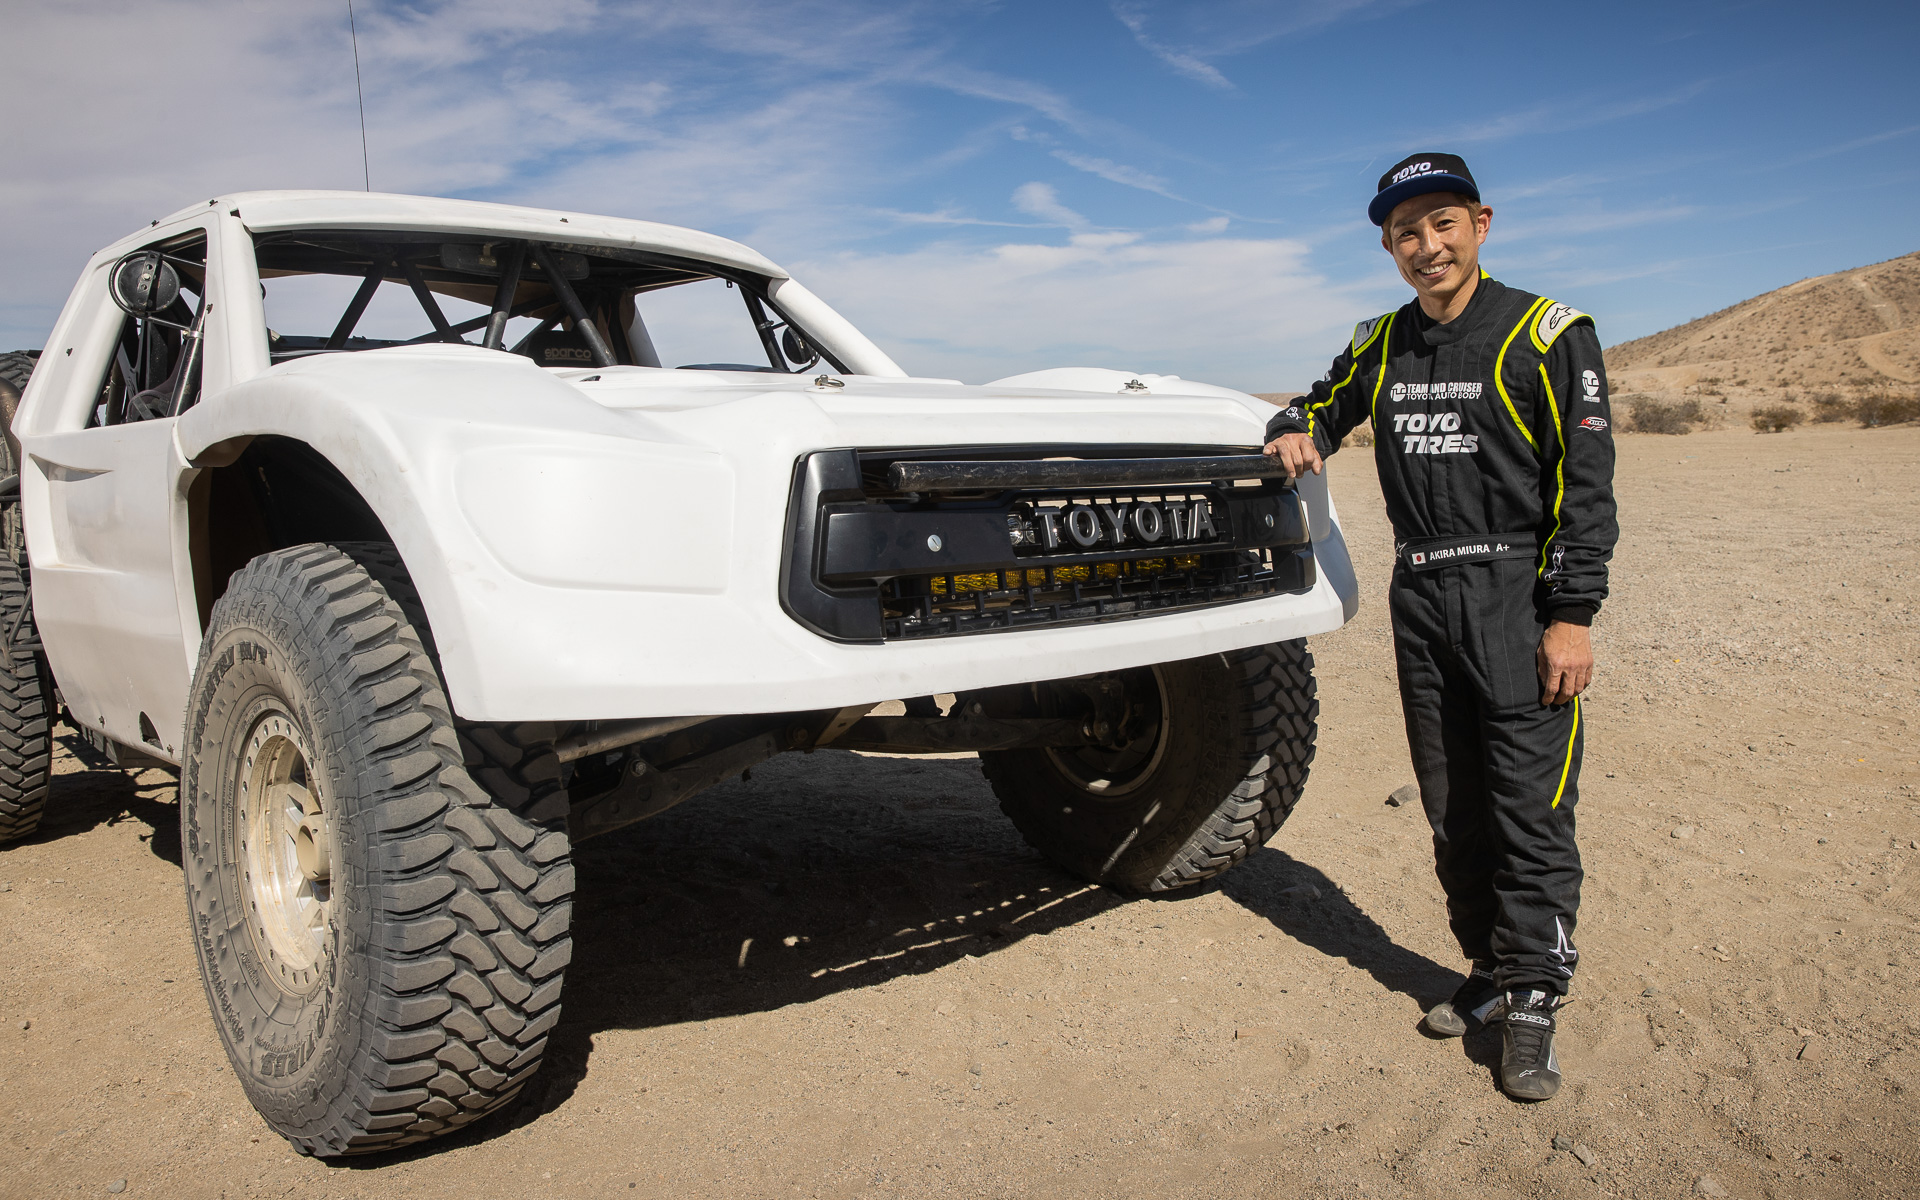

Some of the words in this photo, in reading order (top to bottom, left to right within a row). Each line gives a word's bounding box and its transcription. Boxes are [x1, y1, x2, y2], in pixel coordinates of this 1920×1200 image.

[1392, 162, 1432, 184] TOYO
[544, 347, 592, 359] sparco
[1407, 384, 1428, 393] TEAM
[1447, 382, 1482, 392] CRUISER
[1393, 412, 1462, 433] TOYO
[1403, 434, 1479, 455] TIRES
[1034, 499, 1217, 550] TOYOTA
[1430, 548, 1456, 560] AKIRA
[1456, 543, 1490, 556] MIURA
[1495, 543, 1510, 552] A+
[192, 644, 235, 755] COUNTRY
[239, 641, 268, 665] M/T
[260, 1028, 316, 1078] TIRES
